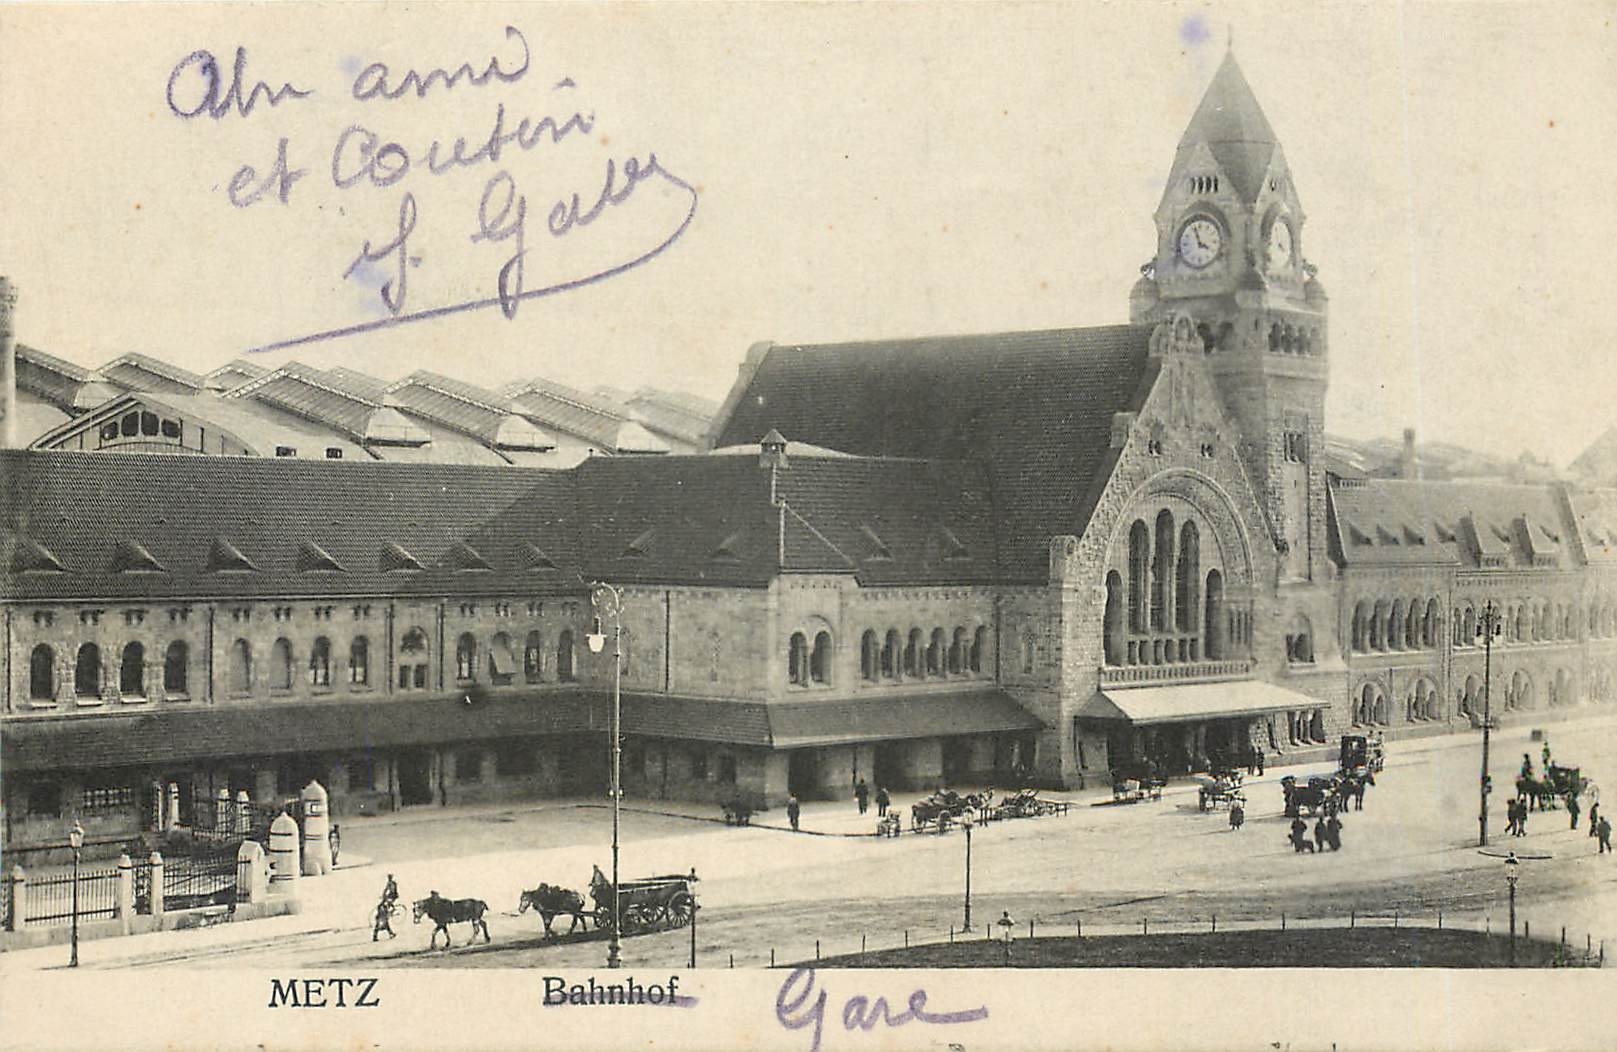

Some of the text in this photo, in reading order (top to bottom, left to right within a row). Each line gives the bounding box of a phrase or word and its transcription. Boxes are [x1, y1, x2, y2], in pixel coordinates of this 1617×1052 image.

[351, 25, 531, 101] ami
[228, 137, 307, 208] et
[775, 966, 989, 1052] Gare
